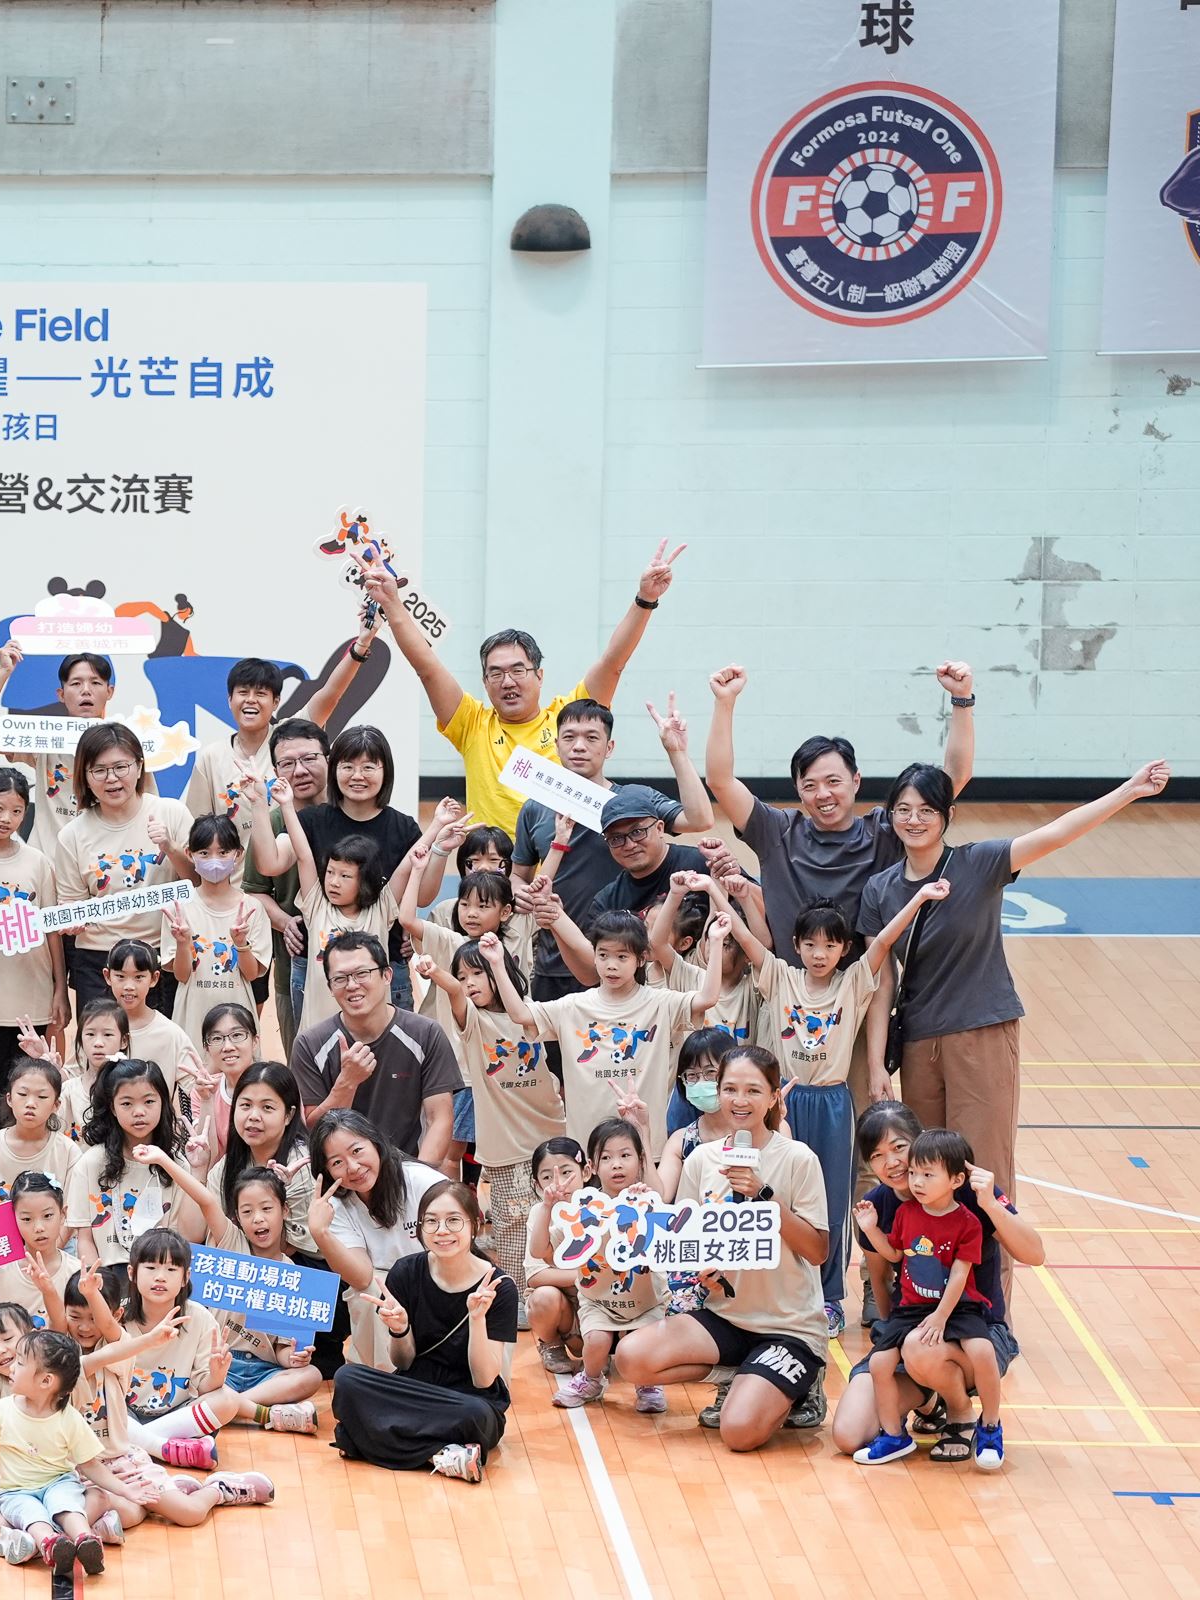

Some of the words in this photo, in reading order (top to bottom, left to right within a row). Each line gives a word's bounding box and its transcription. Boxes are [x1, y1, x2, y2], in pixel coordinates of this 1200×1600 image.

[858, 1, 915, 55] 球
[789, 111, 868, 168] Formosa
[871, 105, 934, 134] Futsal
[931, 127, 963, 165] One
[856, 130, 900, 145] 2024
[783, 185, 817, 226] F
[941, 181, 976, 223] F
[14, 307, 111, 342] Field
[36, 621, 114, 634] 打造婦幼
[402, 592, 447, 639] 2025
[2, 718, 37, 731] Own
[40, 719, 64, 732] the
[535, 770, 602, 809] 桃園市政府婦幼
[43, 884, 191, 928] 桃園市政府婦幼發展局
[196, 979, 235, 989] 桃園女孩日
[702, 1208, 773, 1233] 2025
[653, 1238, 774, 1264] 桃園女孩日
[191, 1253, 303, 1293] 孩運動場域
[202, 1280, 331, 1324] 的平權與挑戰
[751, 1344, 808, 1385] NIKE
